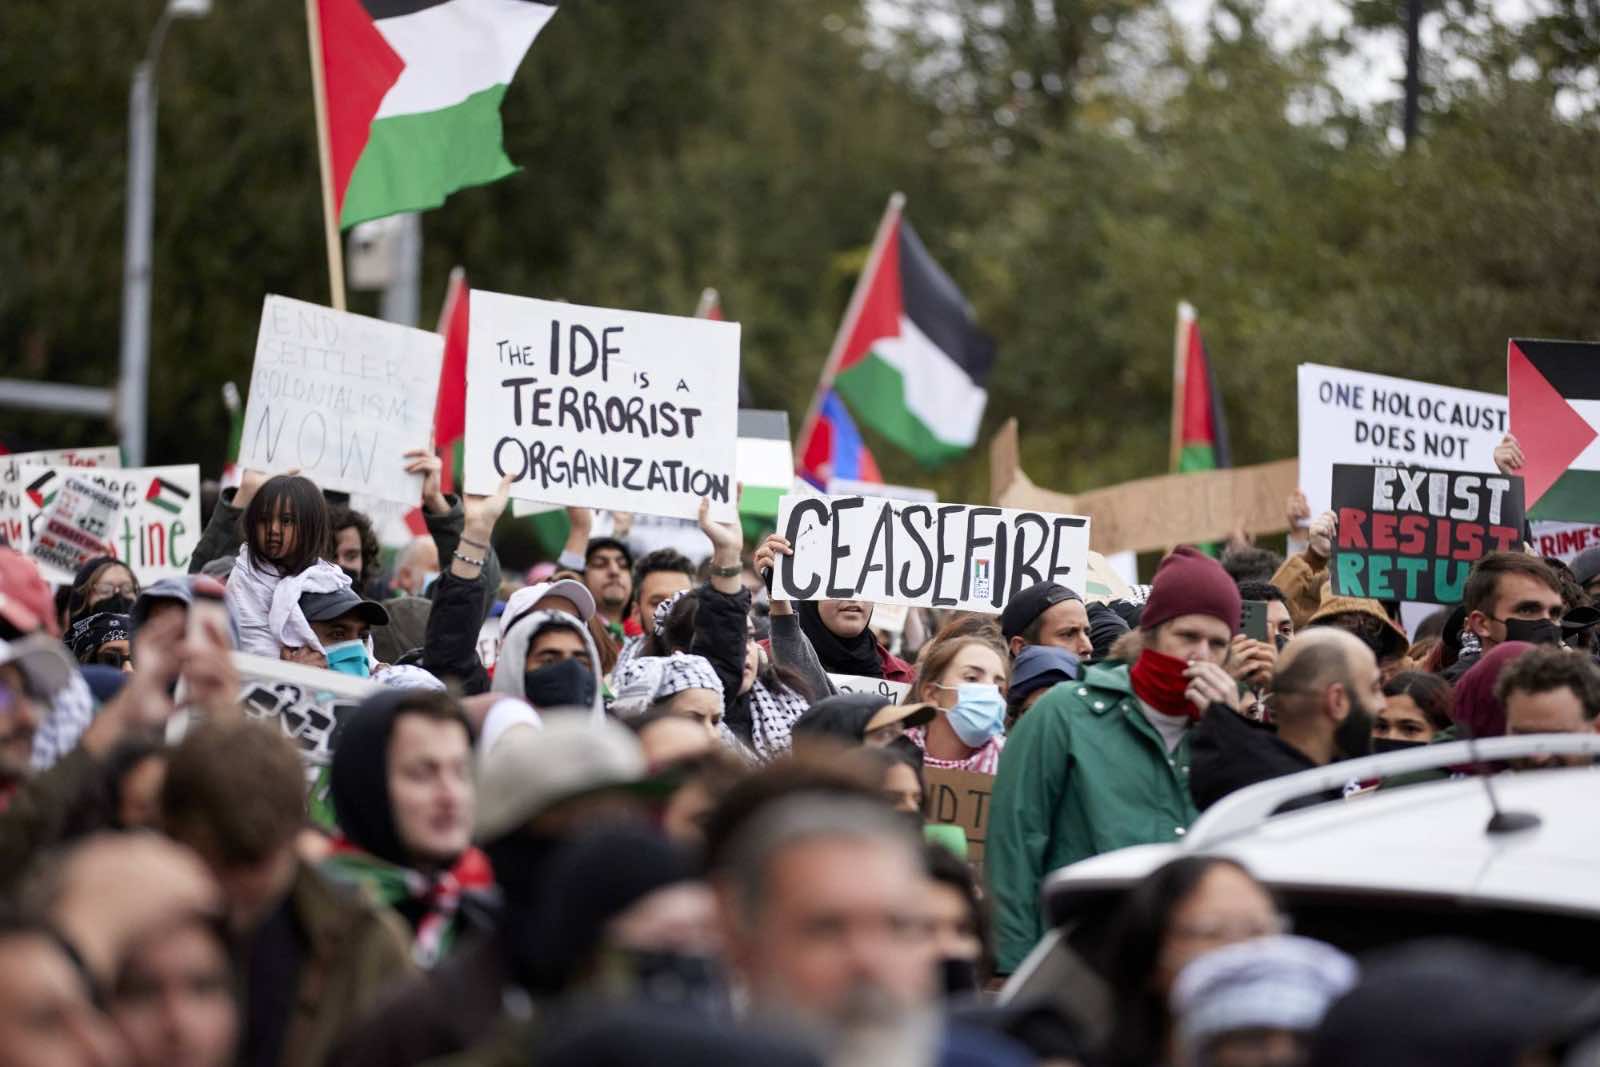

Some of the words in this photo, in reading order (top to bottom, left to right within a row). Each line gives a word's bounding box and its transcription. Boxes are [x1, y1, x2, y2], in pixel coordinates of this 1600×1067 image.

[272, 303, 338, 347] END
[496, 340, 535, 366] THE
[549, 319, 624, 382] IDF
[633, 372, 649, 389] IS
[676, 379, 690, 392] A
[256, 368, 410, 425] COLONIALISM
[501, 377, 702, 438] TERRORIST
[1318, 381, 1364, 411] ONE
[1372, 389, 1507, 432] HOLOCAUST
[251, 404, 378, 485] NOW
[1355, 420, 1416, 452] DOES
[1424, 433, 1469, 460] NOT
[494, 436, 729, 503] ORGANIZATION
[1373, 467, 1510, 525] EXIST
[781, 497, 1086, 608] CEASEFIRE
[1338, 507, 1520, 560] RESIST
[1336, 552, 1472, 604] RETU
